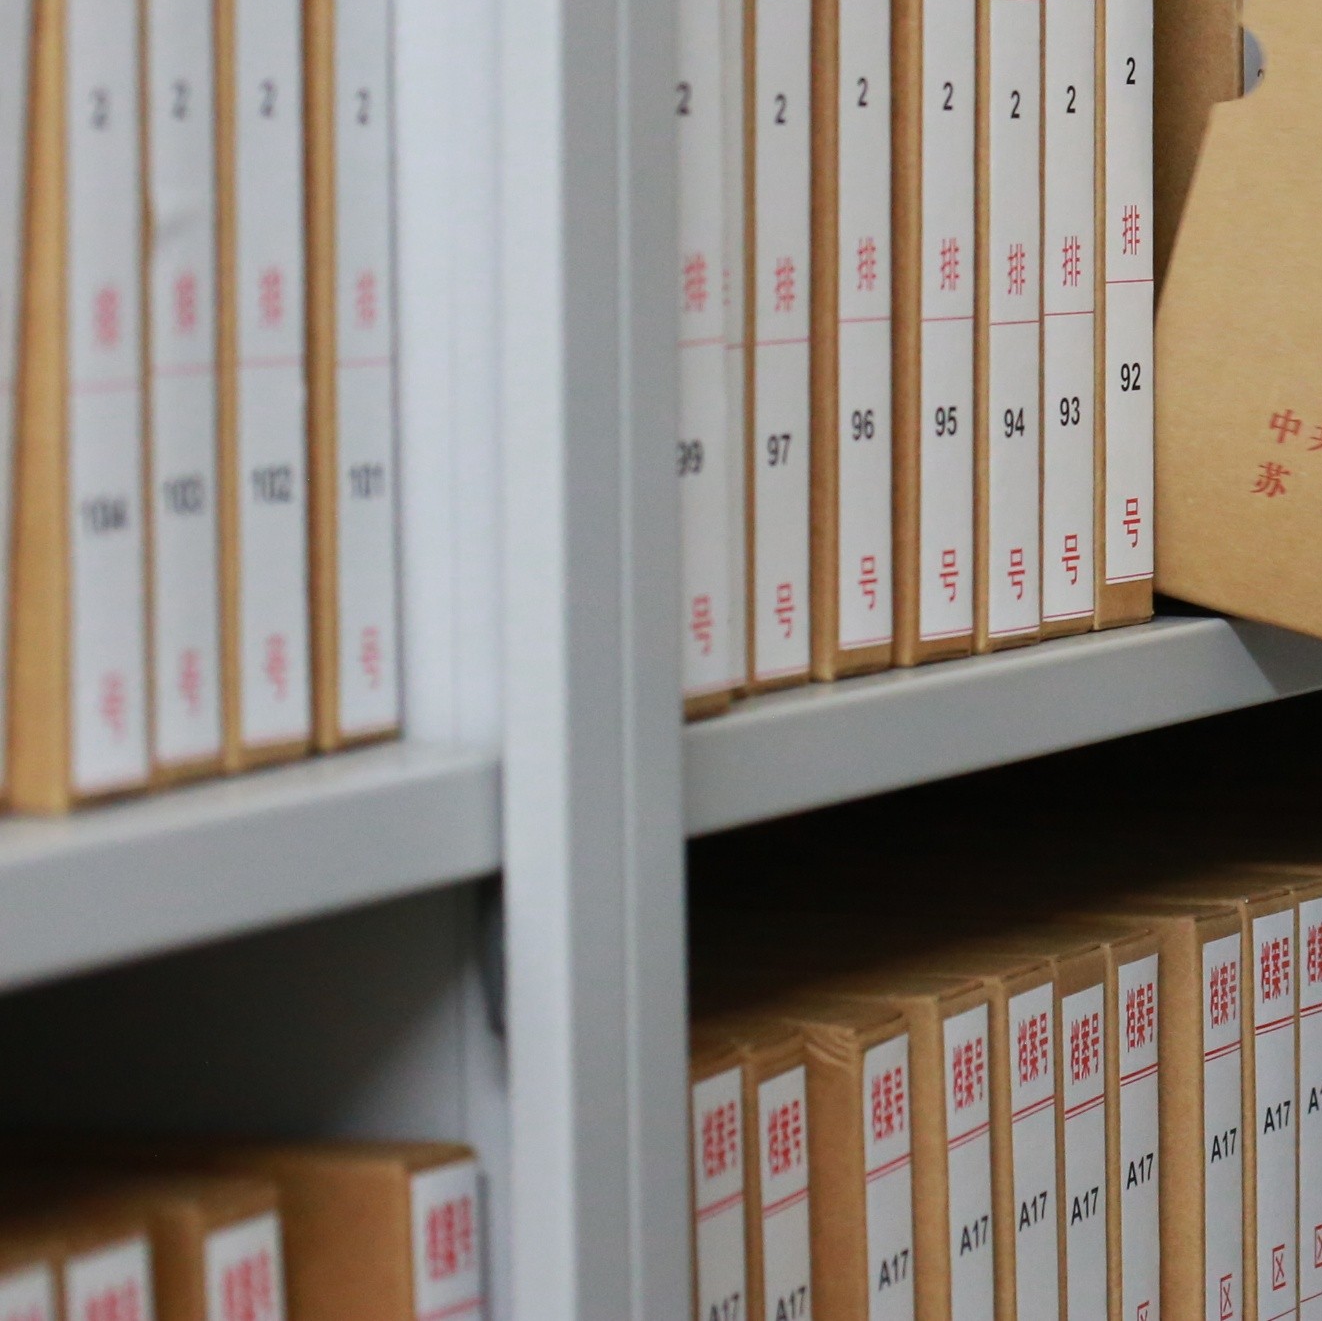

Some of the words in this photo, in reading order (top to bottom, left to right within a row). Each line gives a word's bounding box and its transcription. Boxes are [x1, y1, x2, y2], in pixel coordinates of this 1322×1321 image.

[857, 77, 869, 107] 2
[1126, 57, 1136, 85] 2
[676, 81, 691, 115] 2
[775, 93, 787, 124] 2
[943, 82, 953, 110] 2
[1010, 90, 1021, 119] 2
[1066, 85, 1076, 113] 2
[1122, 205, 1141, 255] 排
[858, 237, 876, 291] 排
[941, 238, 960, 291] 排
[1008, 243, 1026, 296] 排
[1063, 236, 1081, 287] 排
[1120, 363, 1141, 392] 92
[852, 409, 875, 440] 96
[935, 406, 957, 437] 95
[1004, 408, 1025, 437] 94
[1060, 397, 1081, 425] 93
[767, 434, 791, 466] 97
[1123, 498, 1141, 548] 号
[859, 555, 878, 610] 号
[940, 549, 959, 603] 号
[1008, 548, 1026, 600] 号
[1062, 534, 1081, 585] 号
[775, 583, 795, 639] 号
[1261, 937, 1290, 1004] 档案号
[1125, 982, 1155, 1053] 档案号
[1210, 961, 1237, 1029] 档案号
[1017, 1013, 1049, 1087] 档案号
[1070, 1013, 1100, 1086] 档案号
[952, 1037, 984, 1113] 档案号
[871, 1067, 905, 1145] 档案号
[1264, 1100, 1291, 1134] A17
[702, 1100, 737, 1179] 档案号
[767, 1098, 802, 1178] 档案号
[1211, 1128, 1237, 1164] A17
[1127, 1153, 1154, 1190] A17
[1019, 1192, 1047, 1231] A17
[1070, 1187, 1099, 1225] A17
[960, 1216, 988, 1256] A17
[878, 1250, 909, 1292] A17
[1273, 1244, 1285, 1291] 区
[1220, 1274, 1233, 1321] 区
